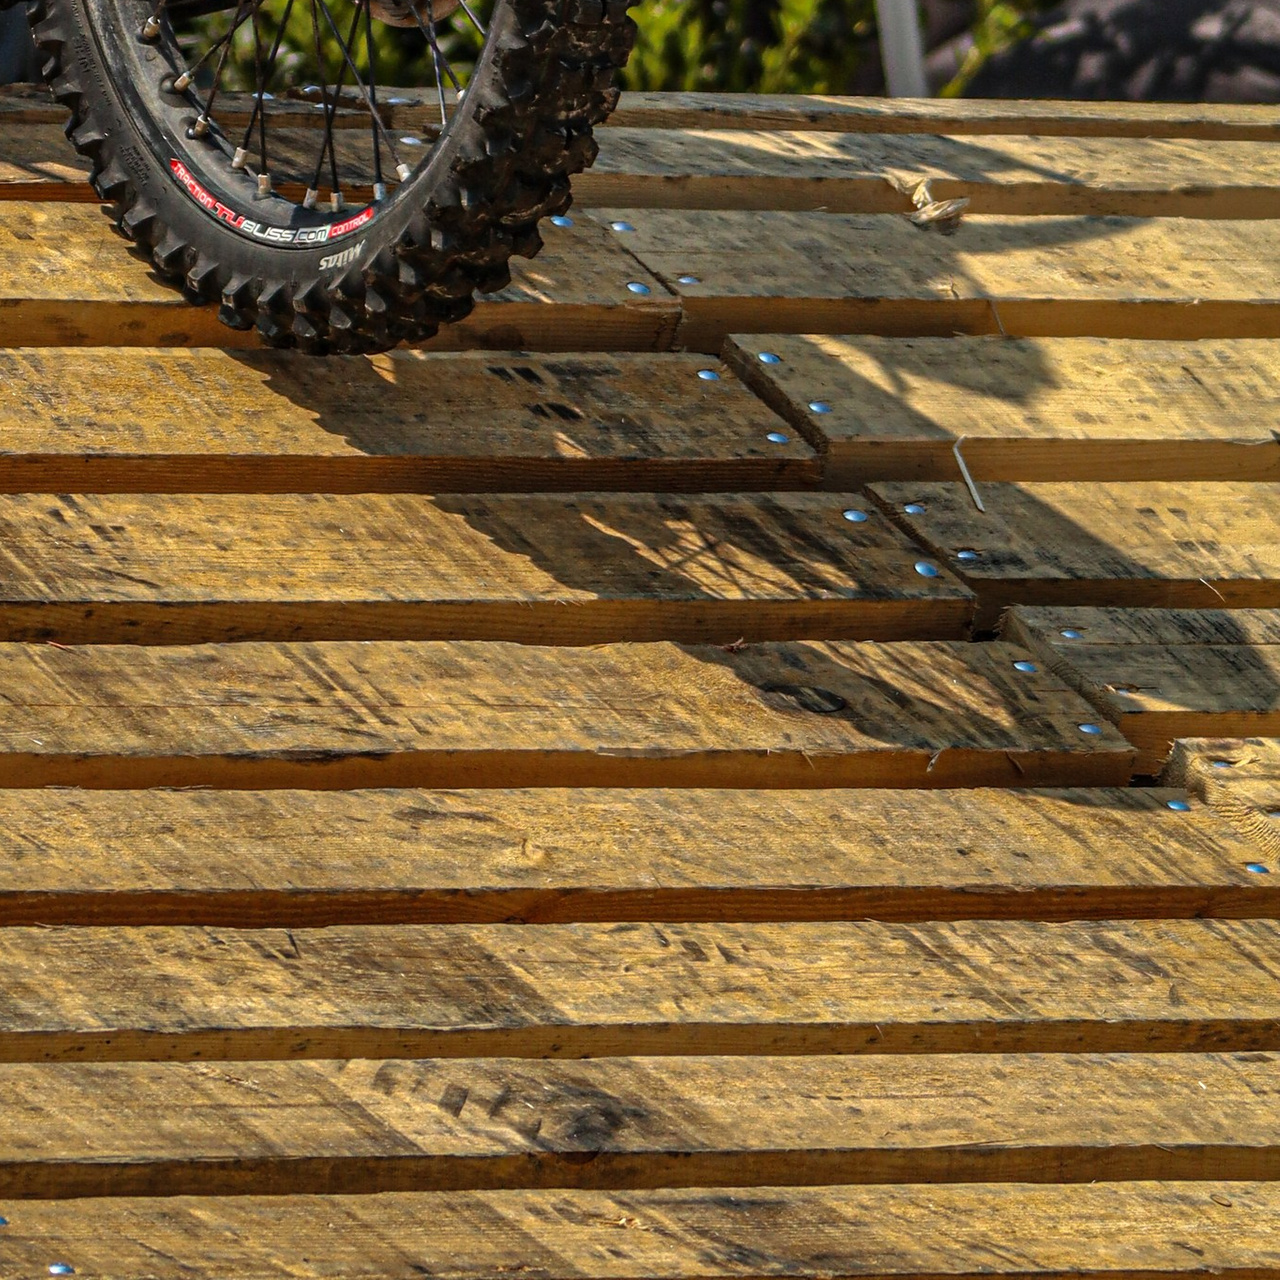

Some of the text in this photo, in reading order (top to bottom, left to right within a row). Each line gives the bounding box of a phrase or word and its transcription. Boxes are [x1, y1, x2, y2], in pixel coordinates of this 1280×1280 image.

[173, 161, 214, 209] TRACTION
[331, 213, 370, 237] CONTROL
[318, 239, 367, 271] Mitas
